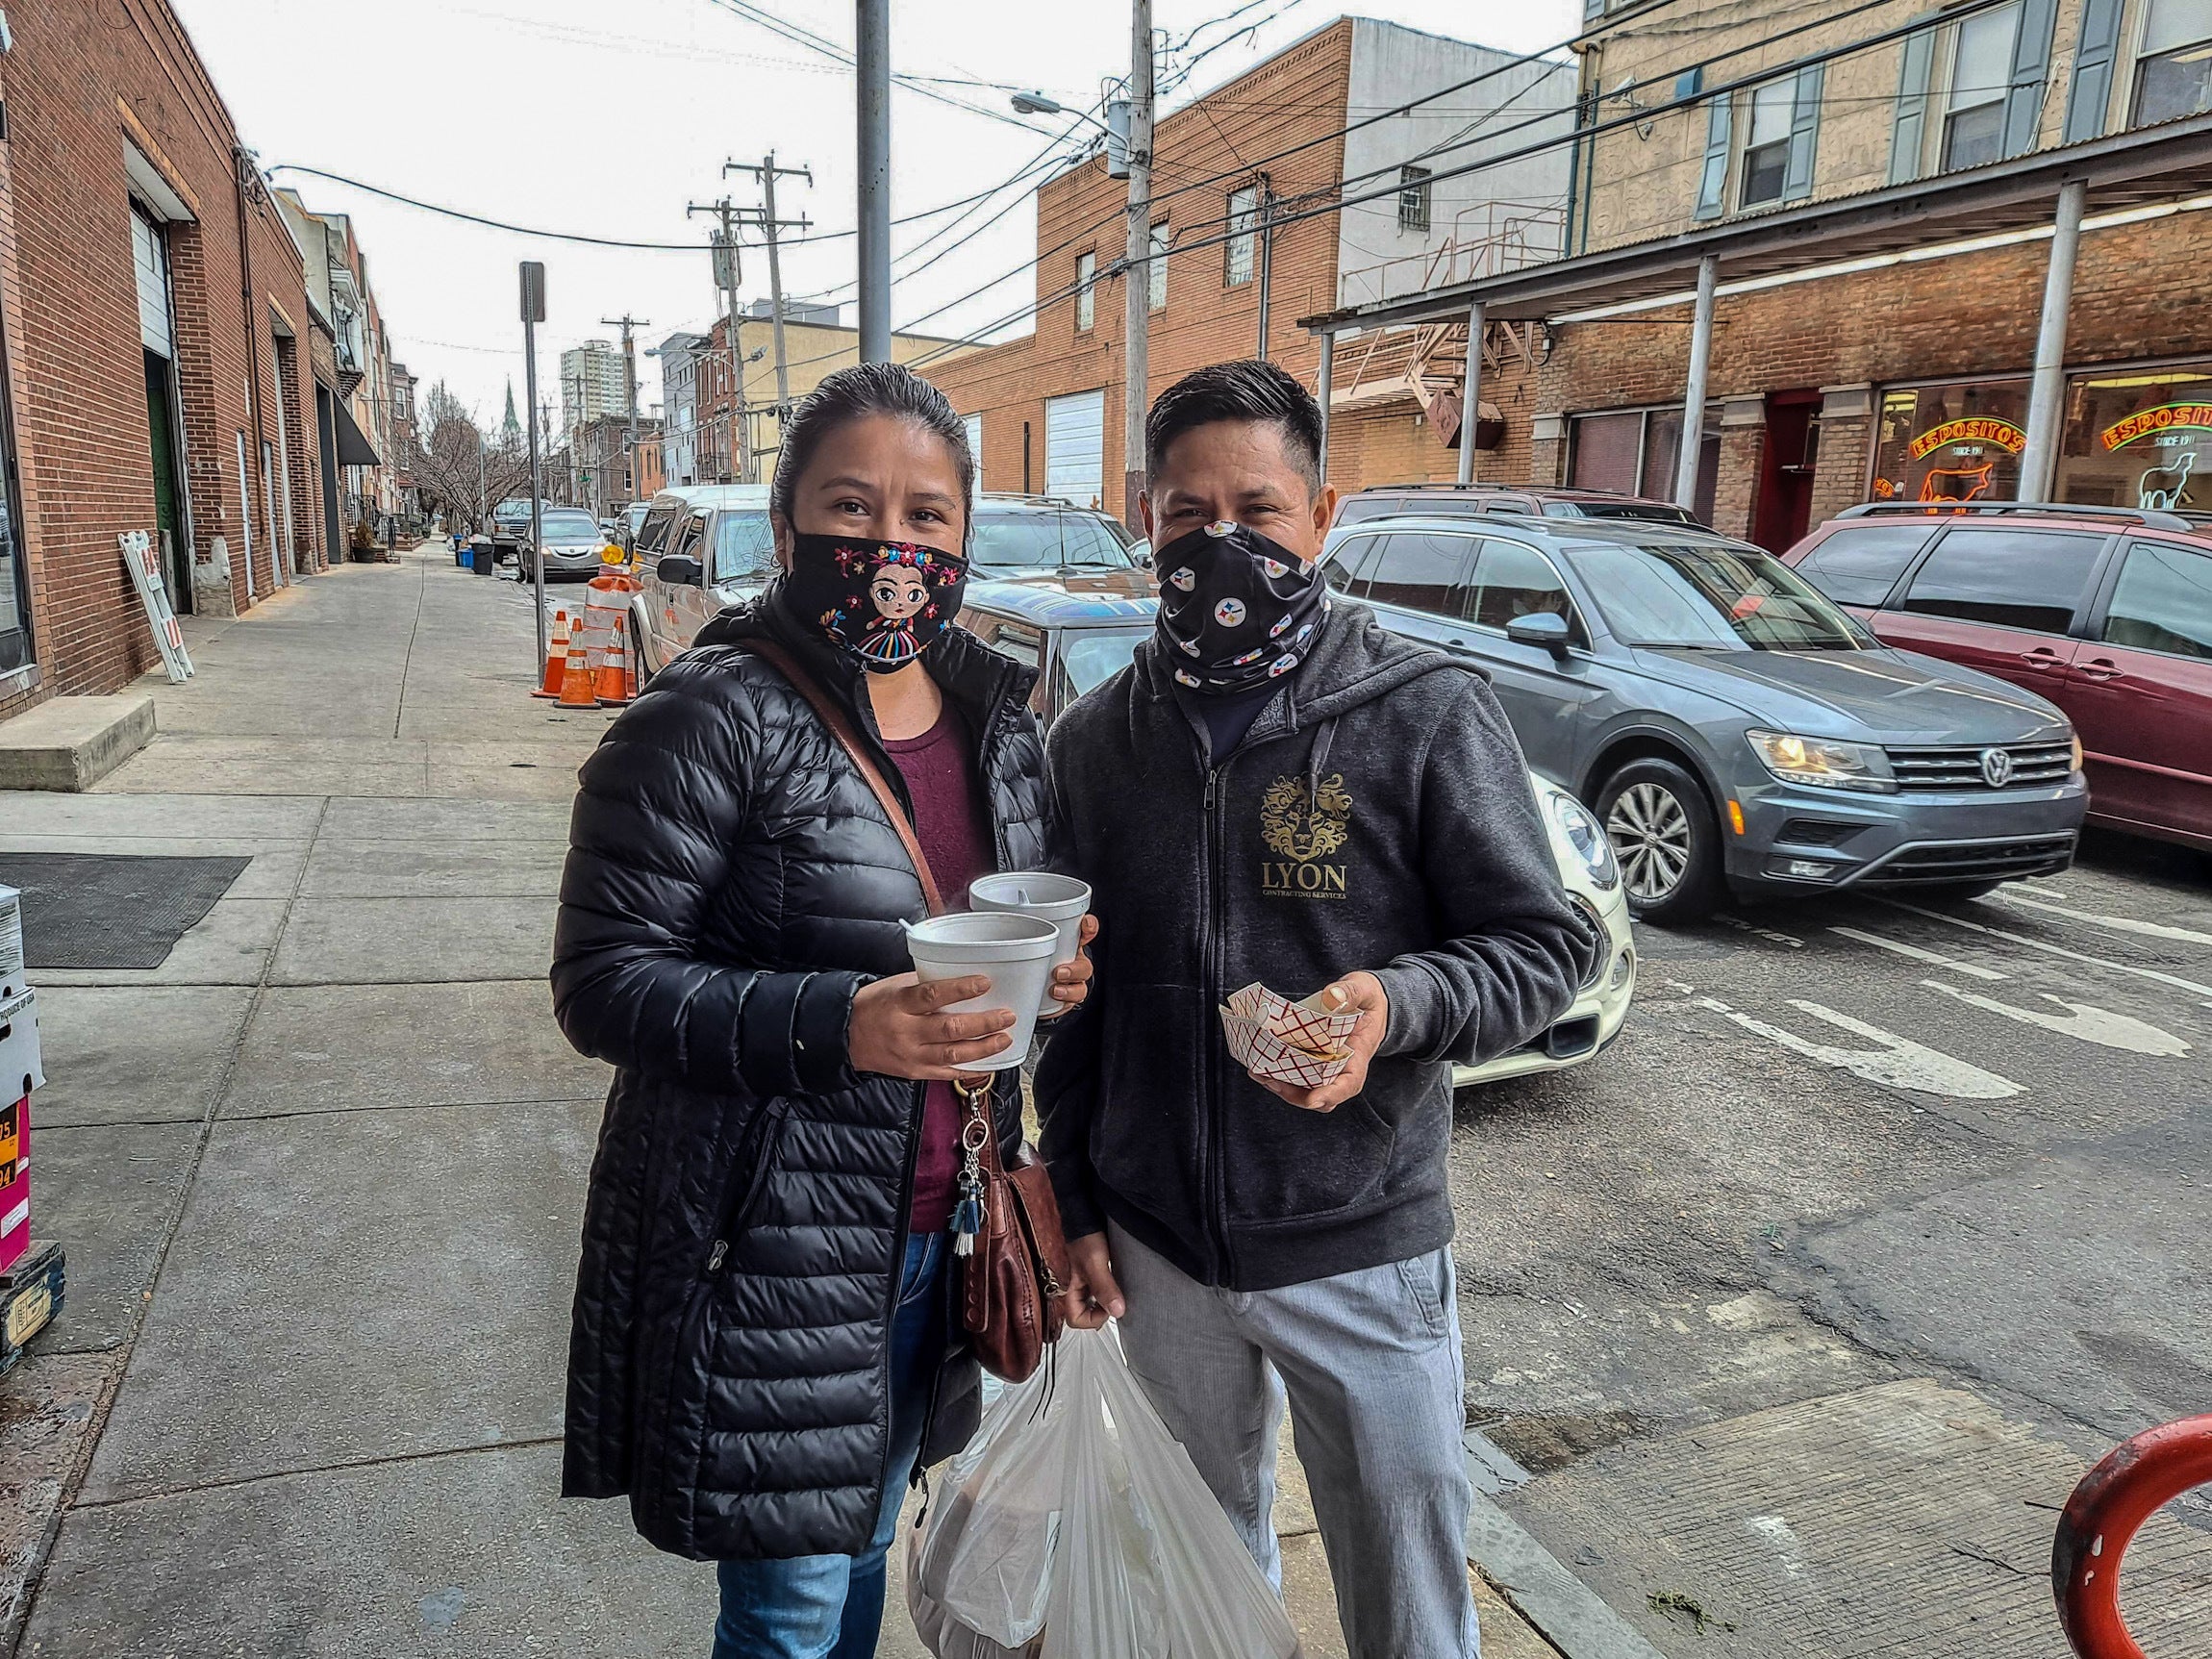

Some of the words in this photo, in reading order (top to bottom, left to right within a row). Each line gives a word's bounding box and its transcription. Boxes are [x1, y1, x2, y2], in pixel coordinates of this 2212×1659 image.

[1912, 421, 2027, 457] ESPOSITO'S
[2155, 436, 2179, 446] SINCE
[1262, 862, 1347, 892] LYON
[1263, 890, 1312, 898] CONTRACTING
[20, 997, 27, 1009] OF
